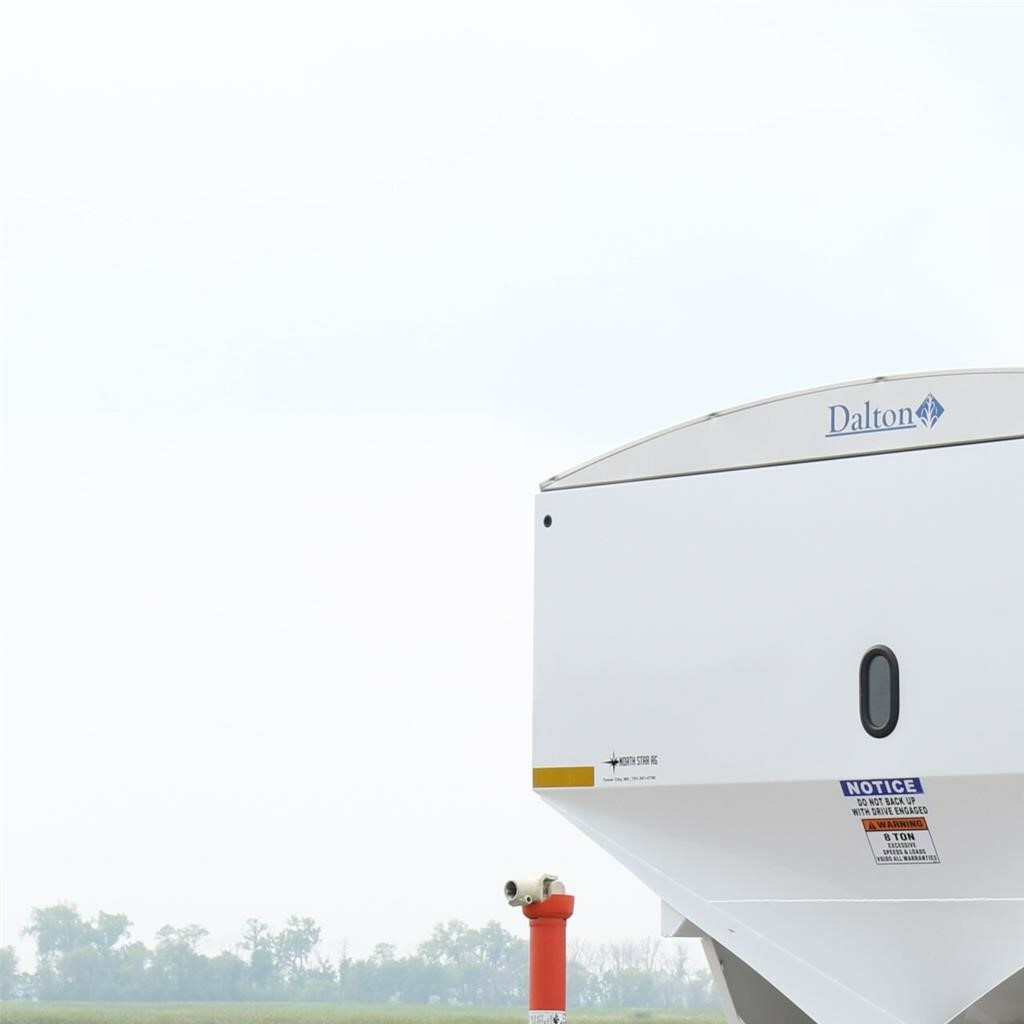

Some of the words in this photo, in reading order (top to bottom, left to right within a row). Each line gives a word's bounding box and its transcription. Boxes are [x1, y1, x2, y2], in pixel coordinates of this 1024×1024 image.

[828, 400, 915, 433] Dalton
[619, 756, 636, 767] NORTH
[636, 755, 650, 766] STAR
[846, 779, 917, 795] NOTICE
[857, 798, 868, 806] DO
[868, 798, 883, 806] NOT
[885, 797, 905, 806] BACK
[905, 796, 916, 805] UP
[852, 808, 870, 816] WITH
[871, 807, 893, 816] DRIVE
[894, 806, 928, 815] ENGAGED
[878, 819, 924, 828] WARNING
[883, 833, 891, 841] 8
[892, 832, 915, 841] TON
